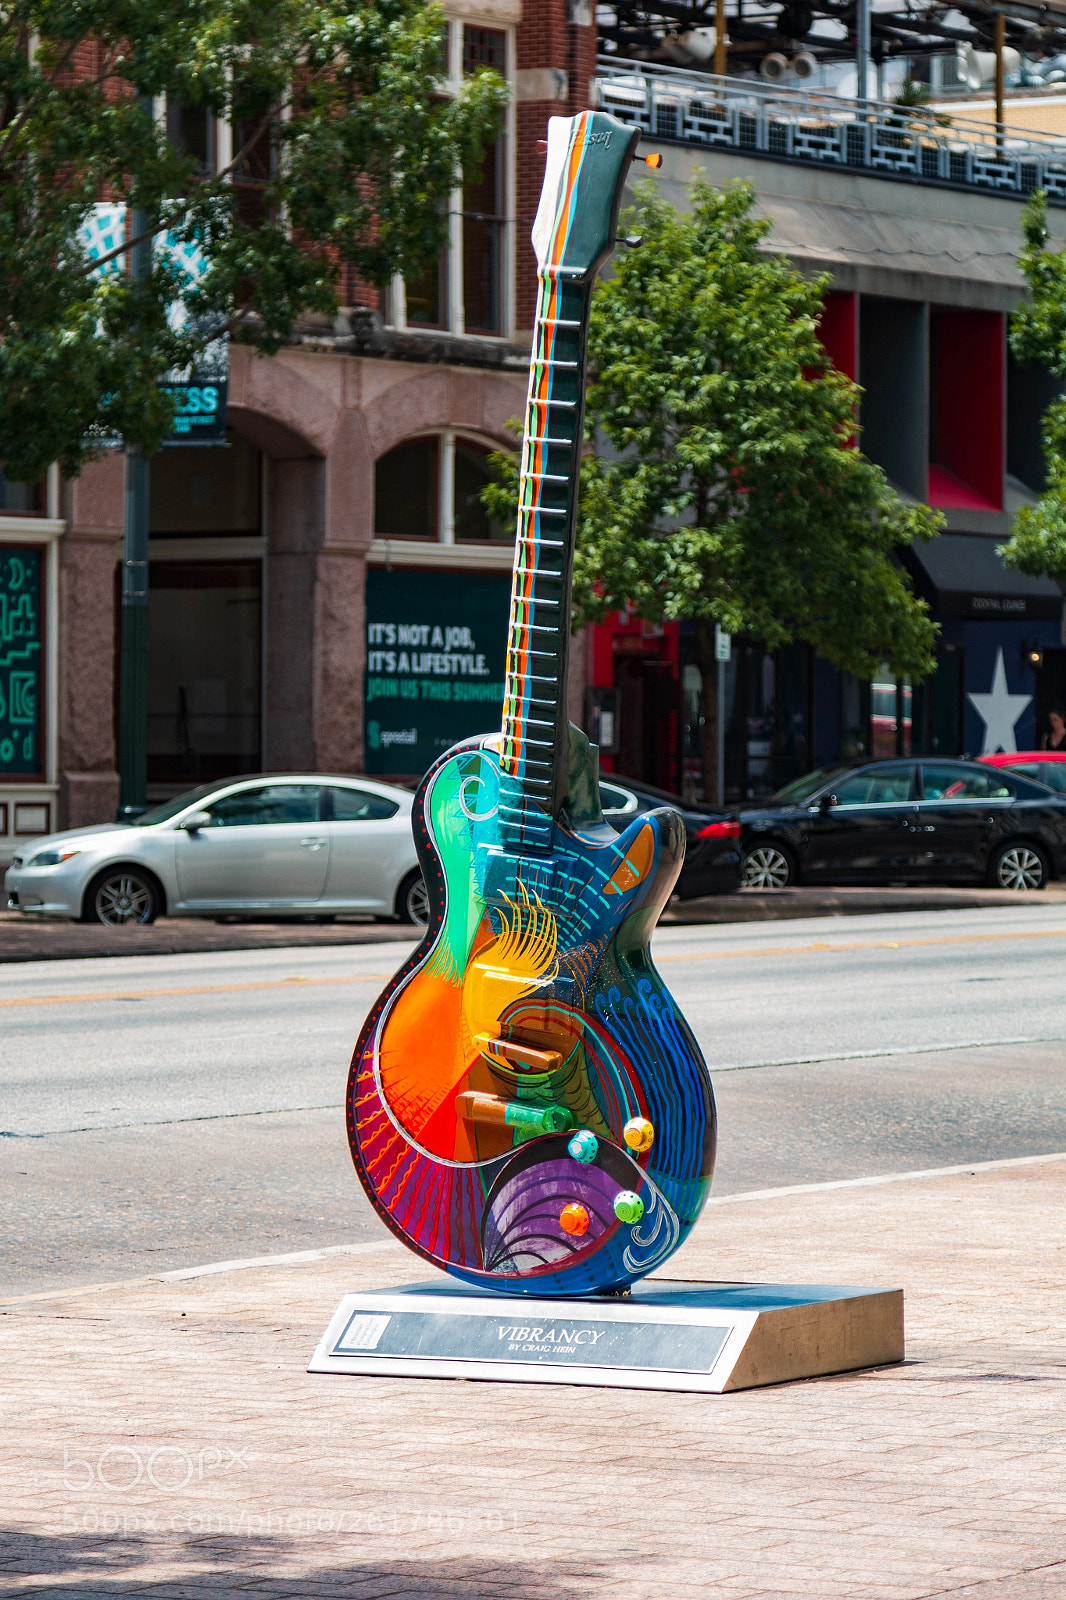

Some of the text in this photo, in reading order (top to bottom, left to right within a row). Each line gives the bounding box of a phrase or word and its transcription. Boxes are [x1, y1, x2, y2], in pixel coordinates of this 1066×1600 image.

[368, 623, 475, 651] IT'S NOT A JOB,
[368, 650, 490, 676] IT'S A LIFESTYLE.
[367, 677, 399, 702] JOIN
[400, 679, 419, 698] US
[420, 680, 452, 700] THIS
[498, 1326, 606, 1345] VIBRANCY
[508, 1343, 577, 1354] BY CRAIG HEIN
